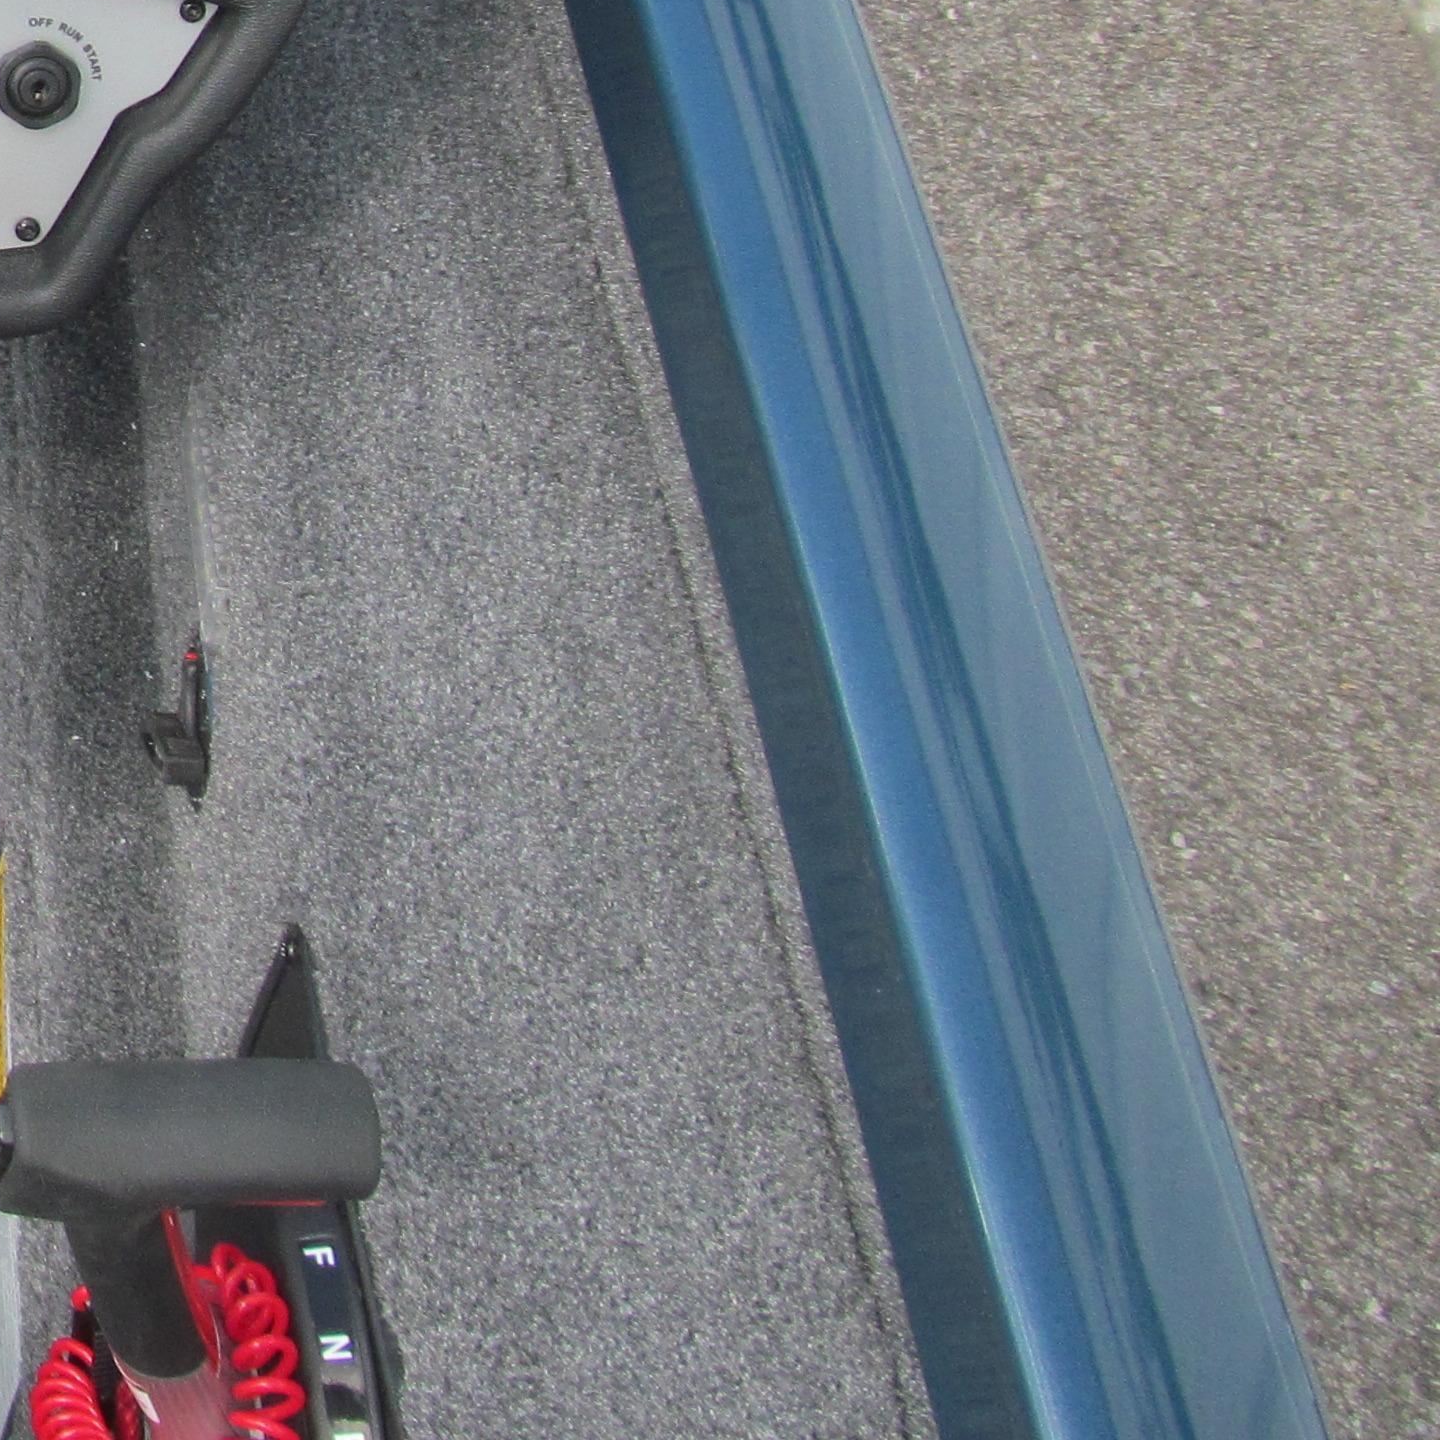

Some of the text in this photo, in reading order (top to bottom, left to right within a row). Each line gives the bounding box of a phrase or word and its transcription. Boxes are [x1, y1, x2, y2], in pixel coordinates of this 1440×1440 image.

[28, 17, 103, 82] OFF RUN START
[302, 1245, 336, 1266] F
[319, 1333, 353, 1361] N
